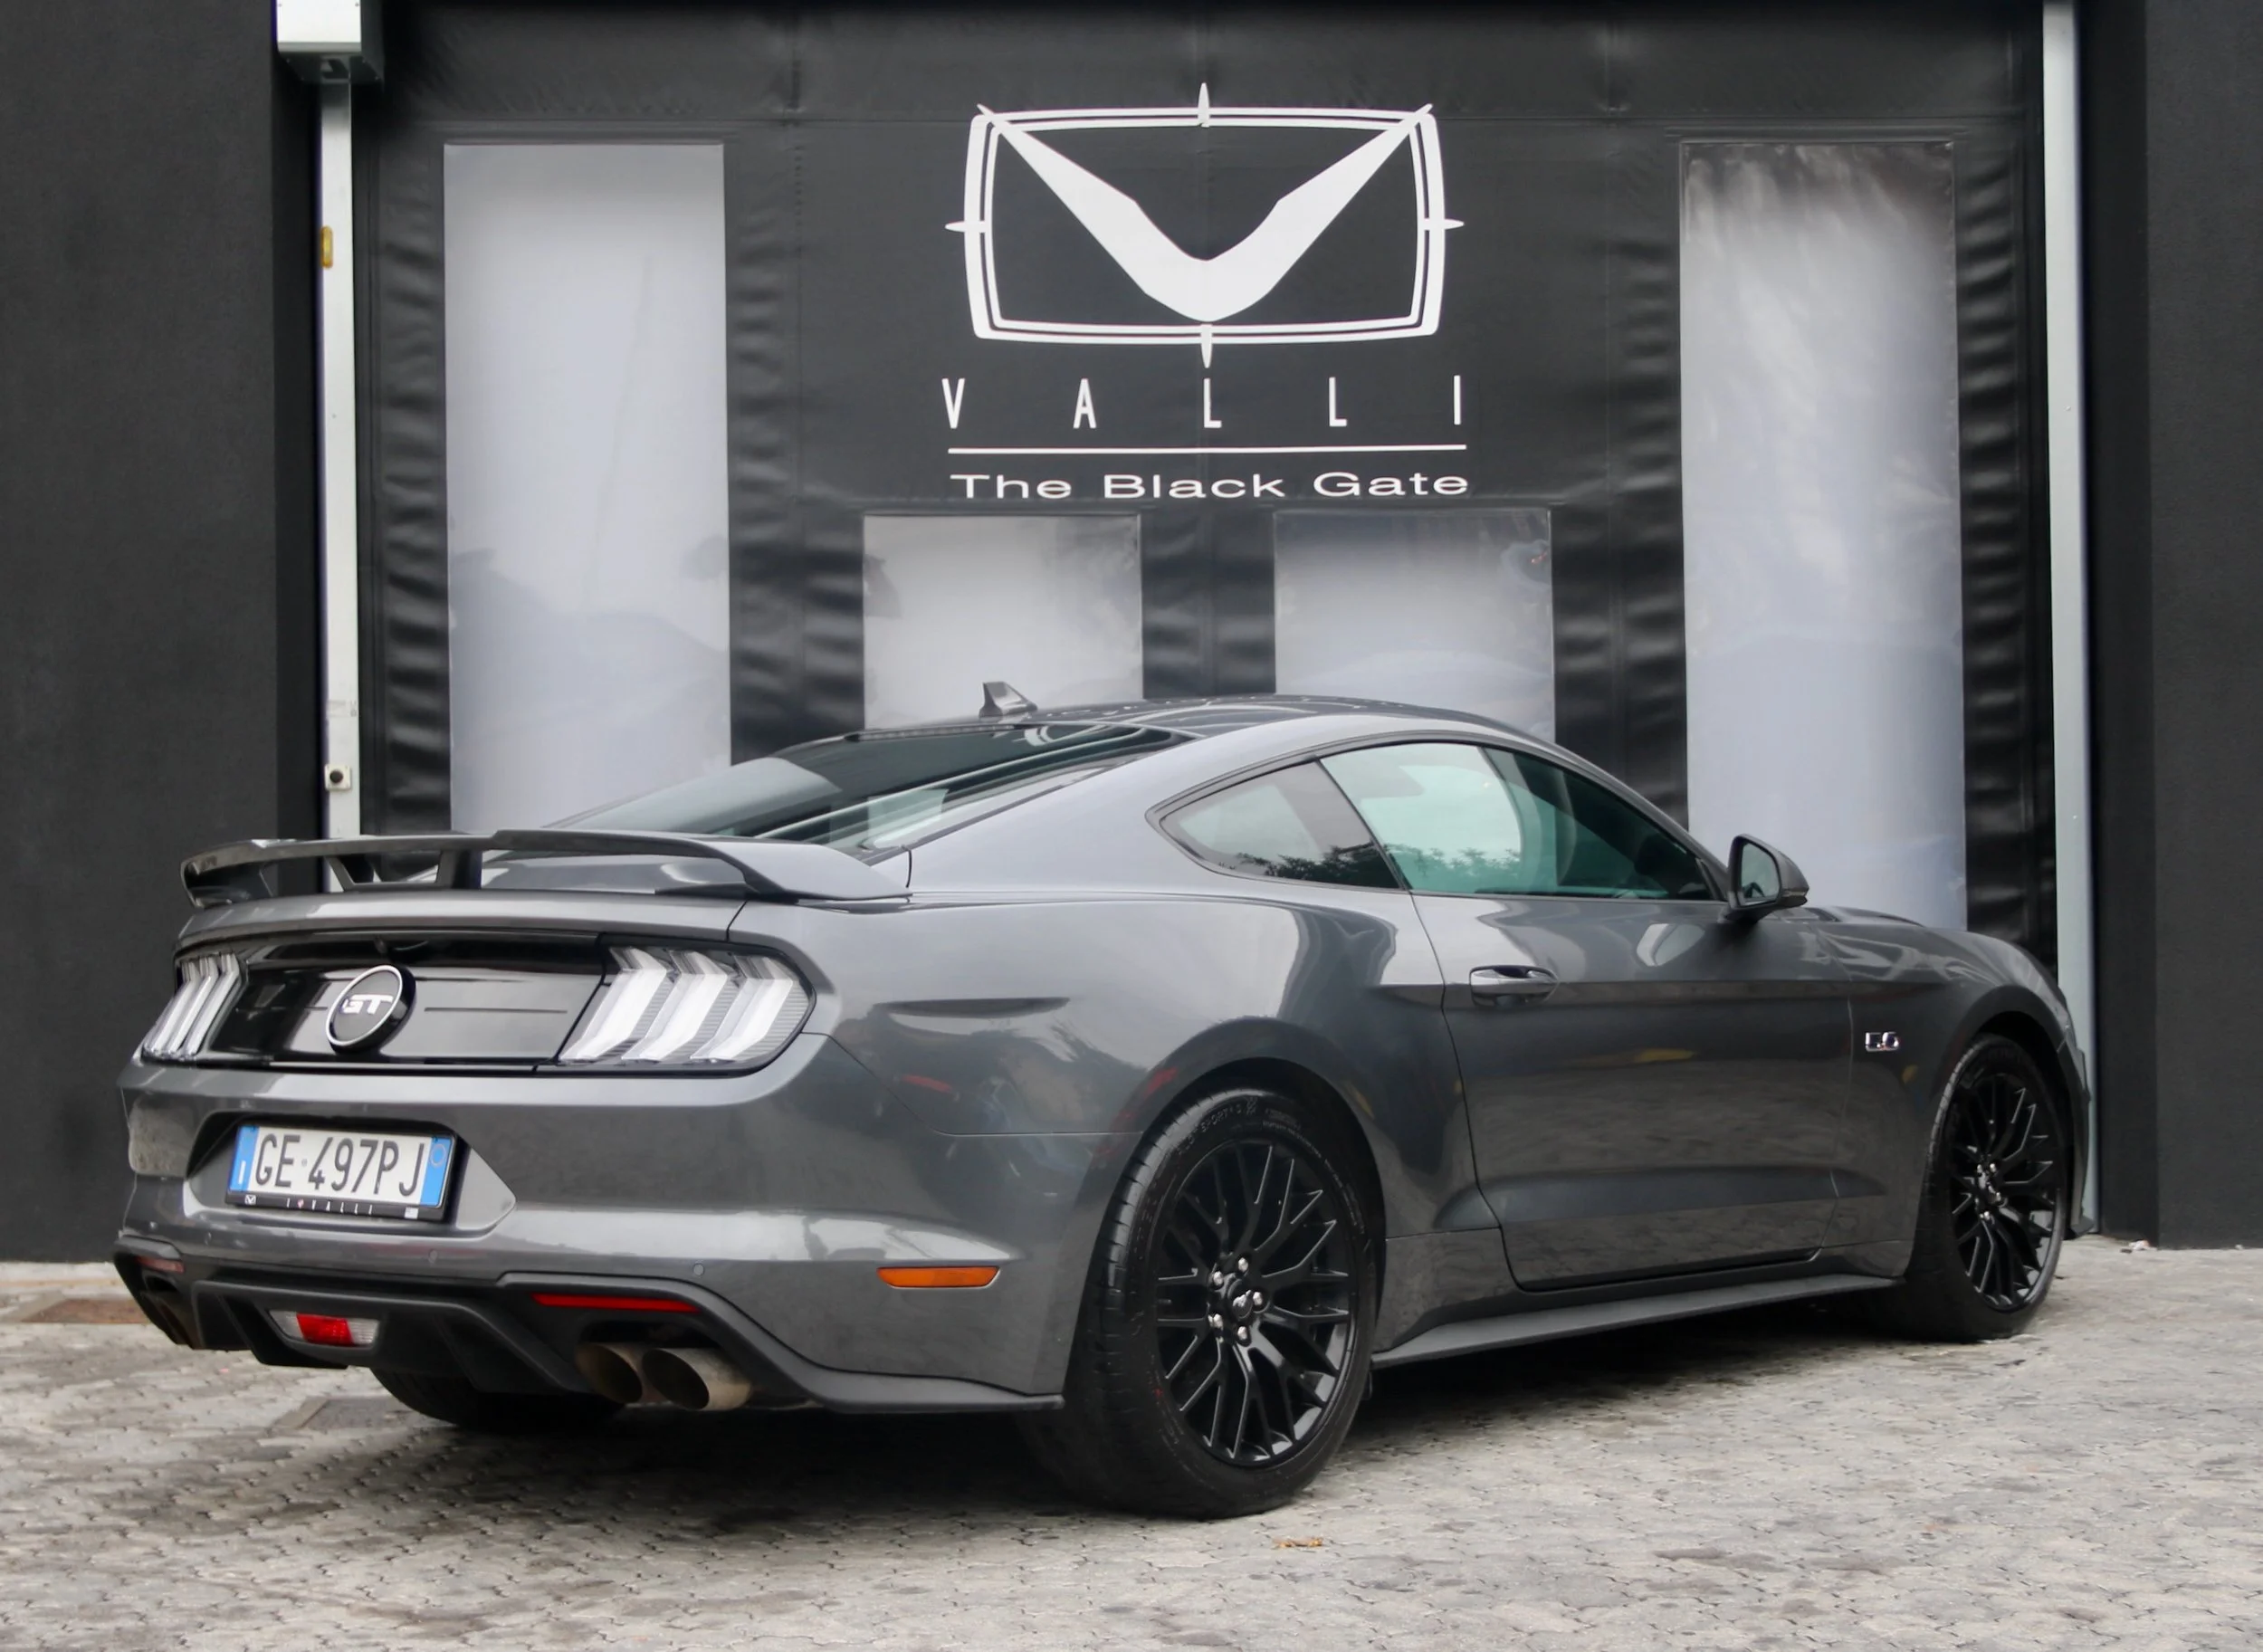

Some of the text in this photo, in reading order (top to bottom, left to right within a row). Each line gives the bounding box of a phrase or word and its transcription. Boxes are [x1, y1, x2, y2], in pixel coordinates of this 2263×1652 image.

[941, 375, 1462, 429] VALLI
[950, 472, 1469, 500] The Black Gate
[341, 994, 394, 1015] GT
[254, 1133, 425, 1197] GE 497PJ
[311, 1198, 373, 1216] VALLI
